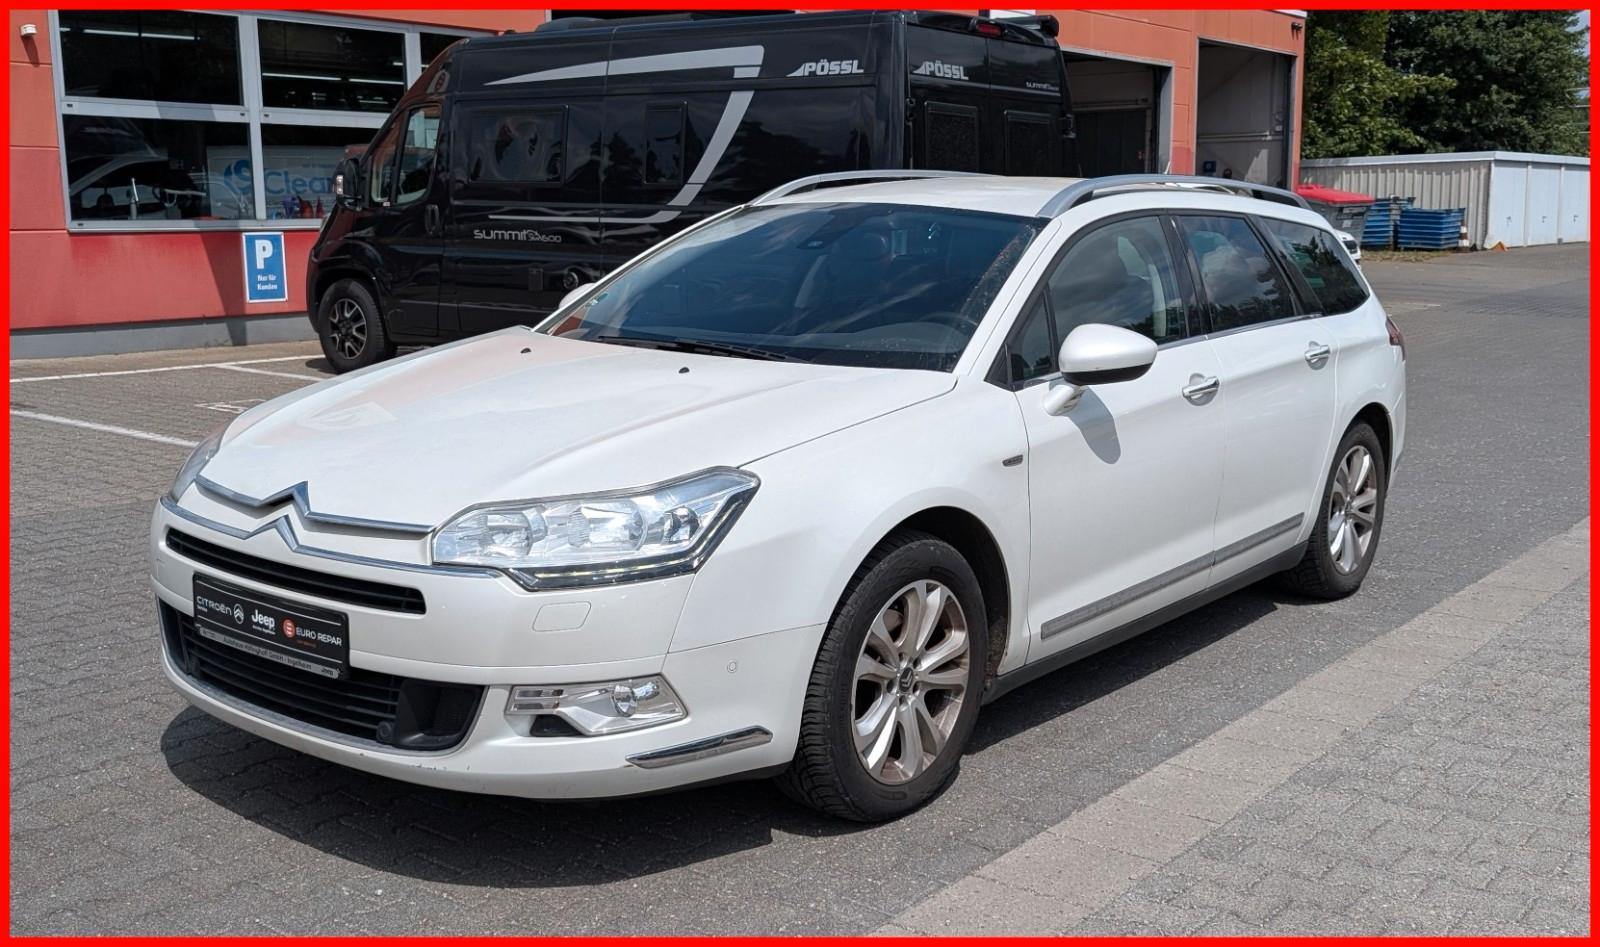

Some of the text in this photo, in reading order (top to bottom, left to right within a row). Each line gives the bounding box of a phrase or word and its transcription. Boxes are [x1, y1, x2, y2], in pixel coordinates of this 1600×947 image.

[804, 59, 864, 76] PÖSSL
[925, 60, 969, 80] PÖSSL
[255, 239, 273, 269] P
[268, 273, 278, 281] für
[251, 609, 275, 630] Jeep
[296, 627, 317, 640] EURO
[317, 632, 343, 647] REPAR
